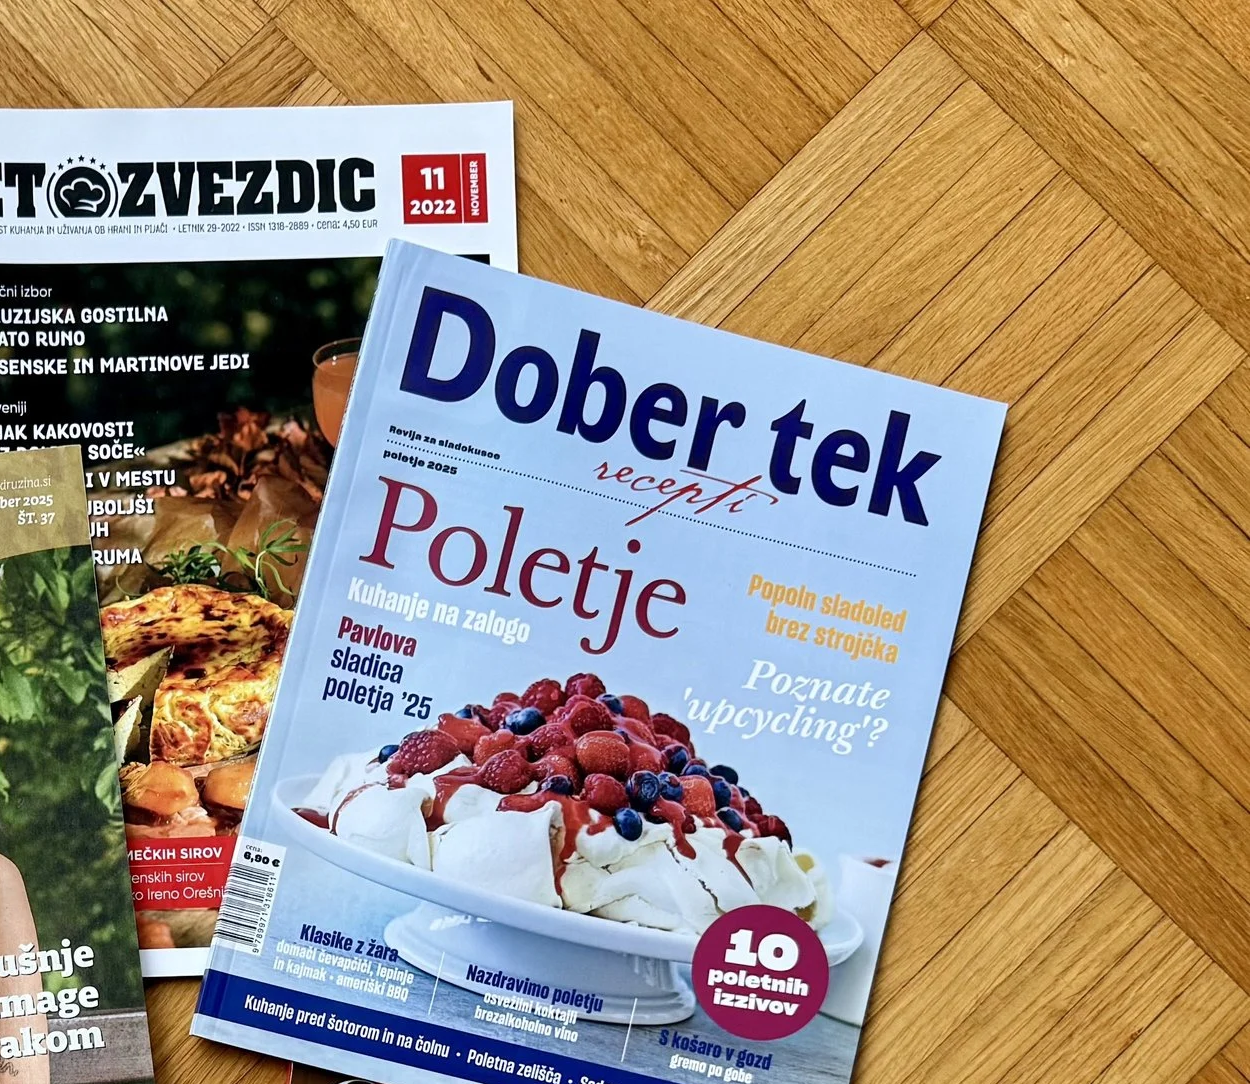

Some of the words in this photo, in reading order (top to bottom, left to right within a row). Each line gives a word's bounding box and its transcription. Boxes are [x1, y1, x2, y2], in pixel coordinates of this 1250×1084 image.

[115, 158, 377, 217] ZVEZDIC
[421, 167, 446, 191] 11
[470, 160, 479, 216] NOVEMBER
[410, 199, 456, 215] 2022
[10, 226, 44, 234] KUHANJA
[47, 225, 54, 234] IN
[57, 224, 92, 234] UŽIVANJA
[95, 225, 105, 234] OB
[108, 225, 131, 234] HRANI
[134, 225, 142, 233] IN
[178, 223, 204, 233] LETNIK
[207, 223, 239, 232] 29-2022
[248, 222, 265, 231] ISSN
[269, 221, 309, 231] 1318-2889
[343, 220, 360, 229] 4,50
[362, 220, 377, 228] EUR
[20, 285, 52, 297] izbor
[81, 307, 168, 323] GOSTILNA
[399, 286, 744, 472] Dober
[770, 399, 942, 526] tek
[383, 449, 425, 468] poletje
[427, 460, 458, 476] 2025
[23, 494, 53, 506] 2025
[593, 461, 778, 526] recepti
[18, 512, 38, 525] ŠT.
[40, 512, 55, 524] 37
[359, 476, 687, 655] Poletje
[338, 616, 417, 657] Pavlova
[331, 647, 403, 684] sladica
[724, 928, 799, 971] 10
[708, 968, 808, 996] poletnih
[713, 988, 800, 1016] izzivov
[245, 995, 294, 1021] Kuhanje
[296, 1010, 325, 1028] pred
[327, 1013, 379, 1041] šotorom
[382, 1027, 394, 1042] in
[397, 1033, 412, 1048] na
[415, 1036, 449, 1058] čolnu
[467, 1050, 515, 1074] Poletna
[516, 1059, 561, 1084] zelišča
